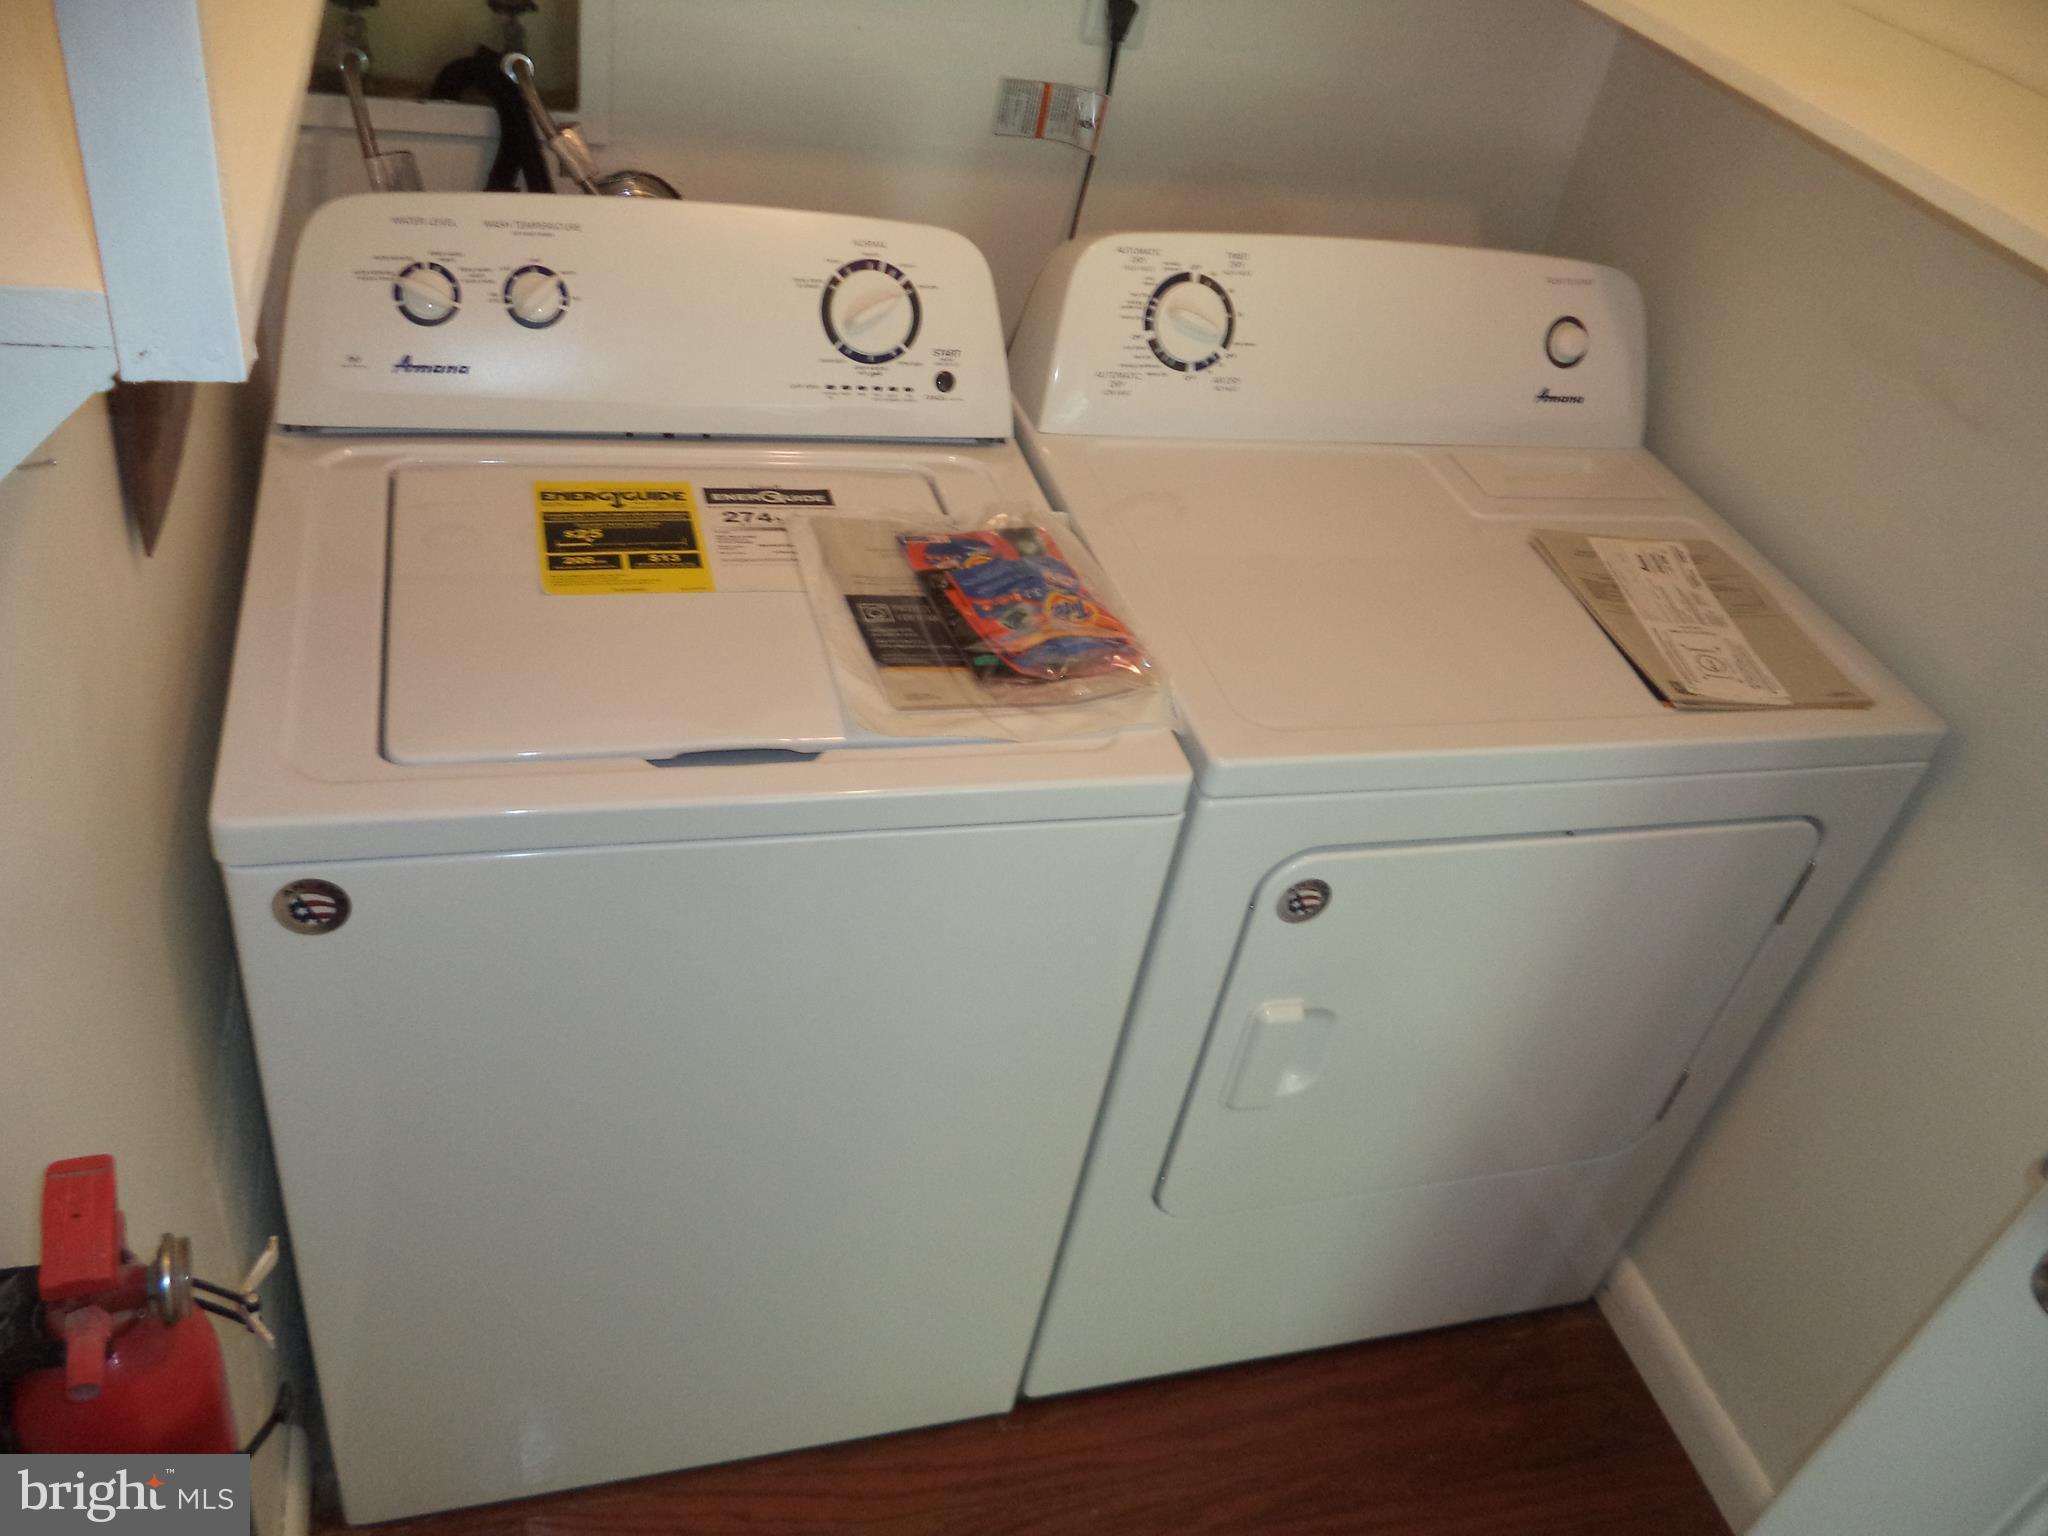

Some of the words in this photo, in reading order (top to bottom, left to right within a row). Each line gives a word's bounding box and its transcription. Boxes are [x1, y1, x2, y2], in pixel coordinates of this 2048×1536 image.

[391, 354, 471, 374] Amana
[1536, 387, 1584, 403] Amana
[540, 491, 688, 508] ENERGYGUIDE
[721, 511, 773, 523] 274
